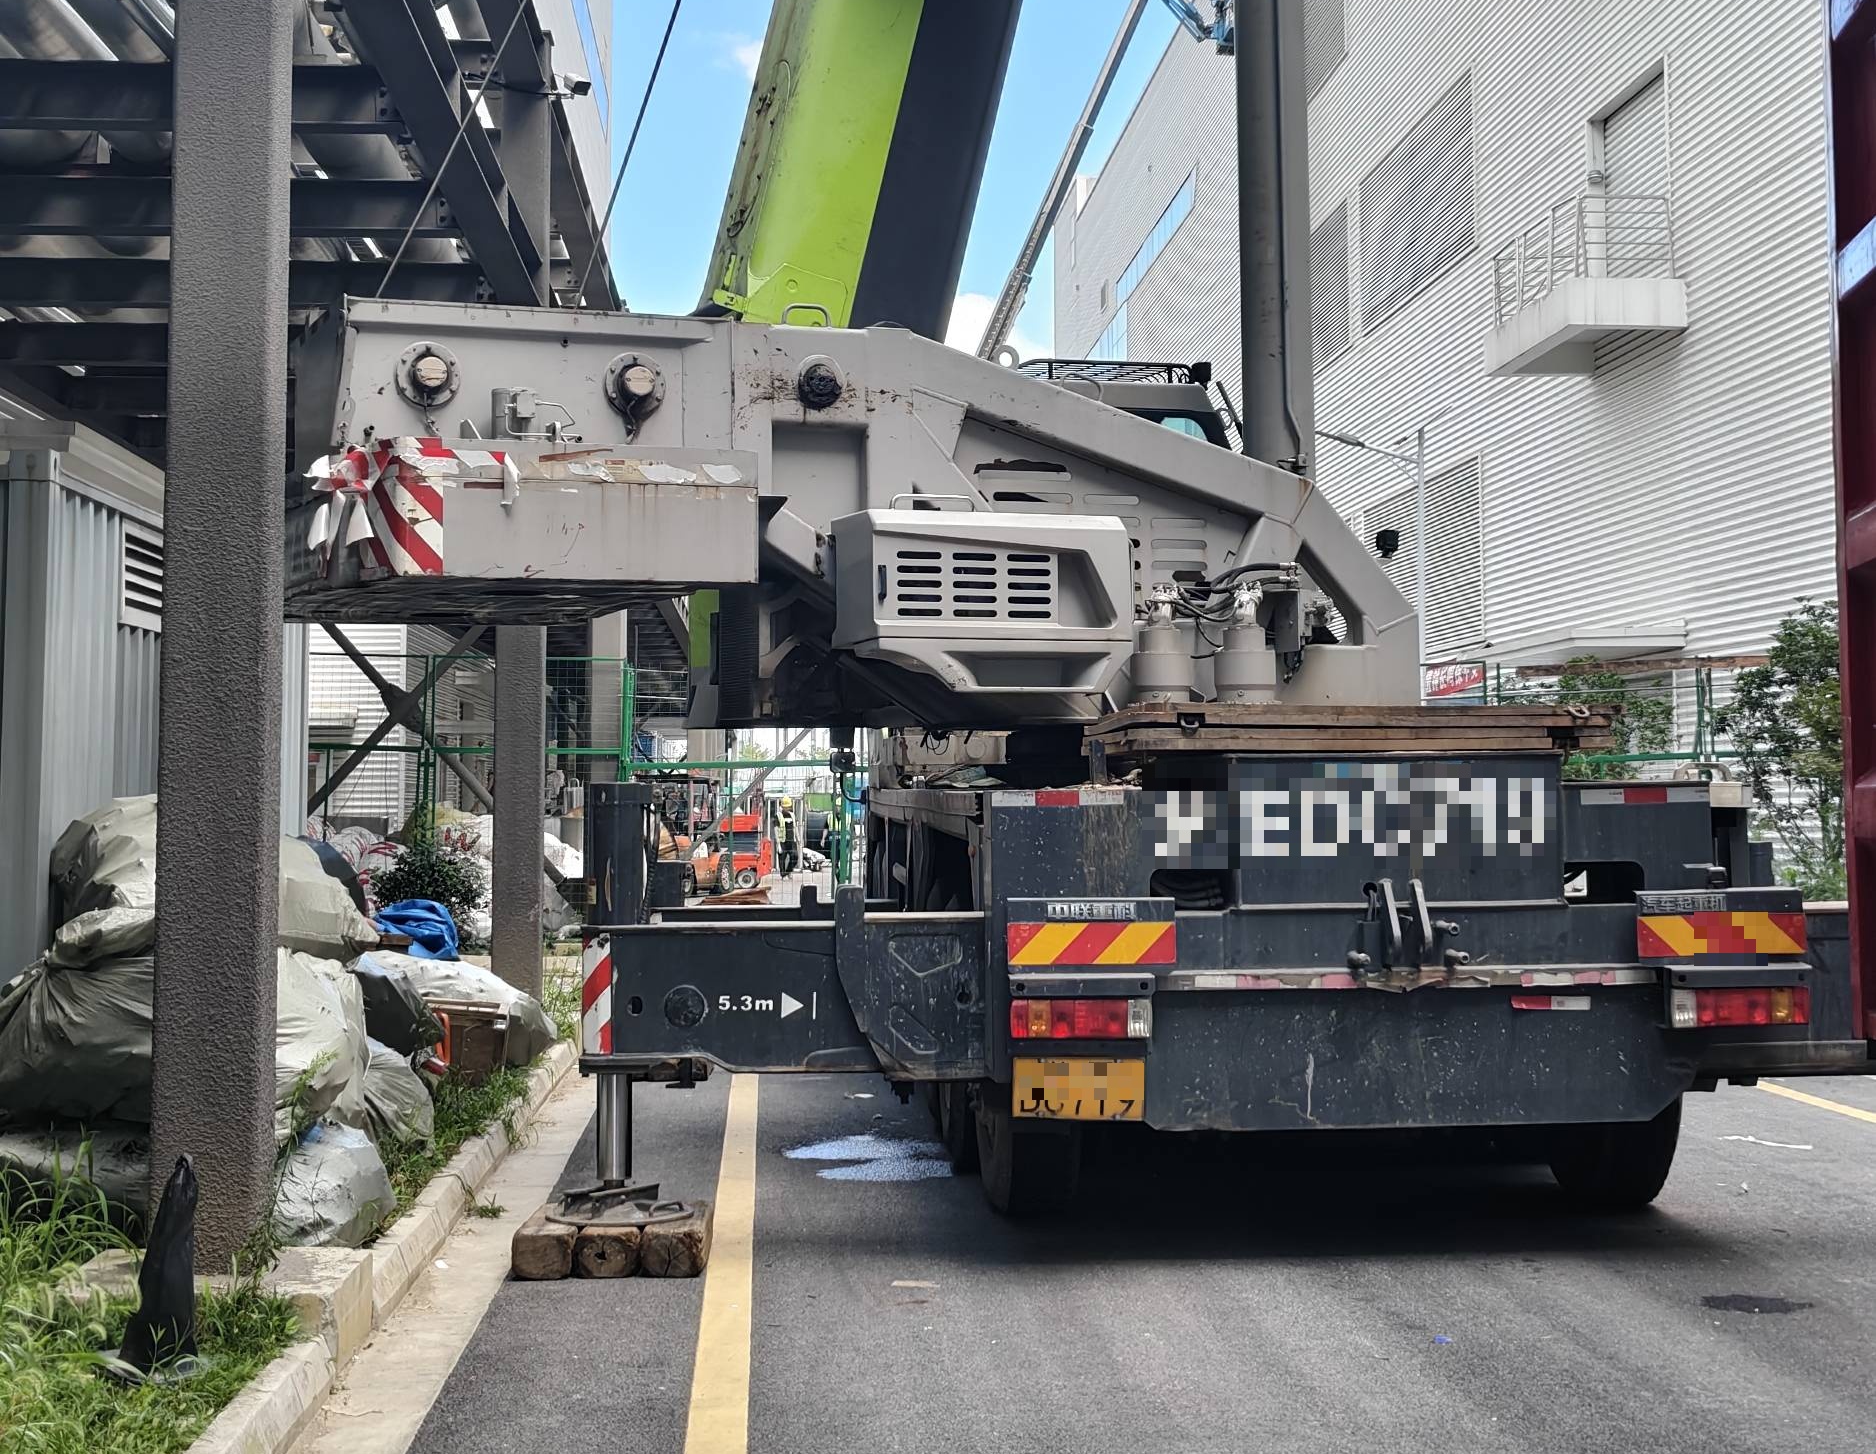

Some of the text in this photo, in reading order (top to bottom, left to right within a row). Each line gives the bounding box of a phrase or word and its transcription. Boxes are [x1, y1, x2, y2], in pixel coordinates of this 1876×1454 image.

[1641, 895, 1727, 914] 汽车起重机
[718, 995, 774, 1012] 5.3m
